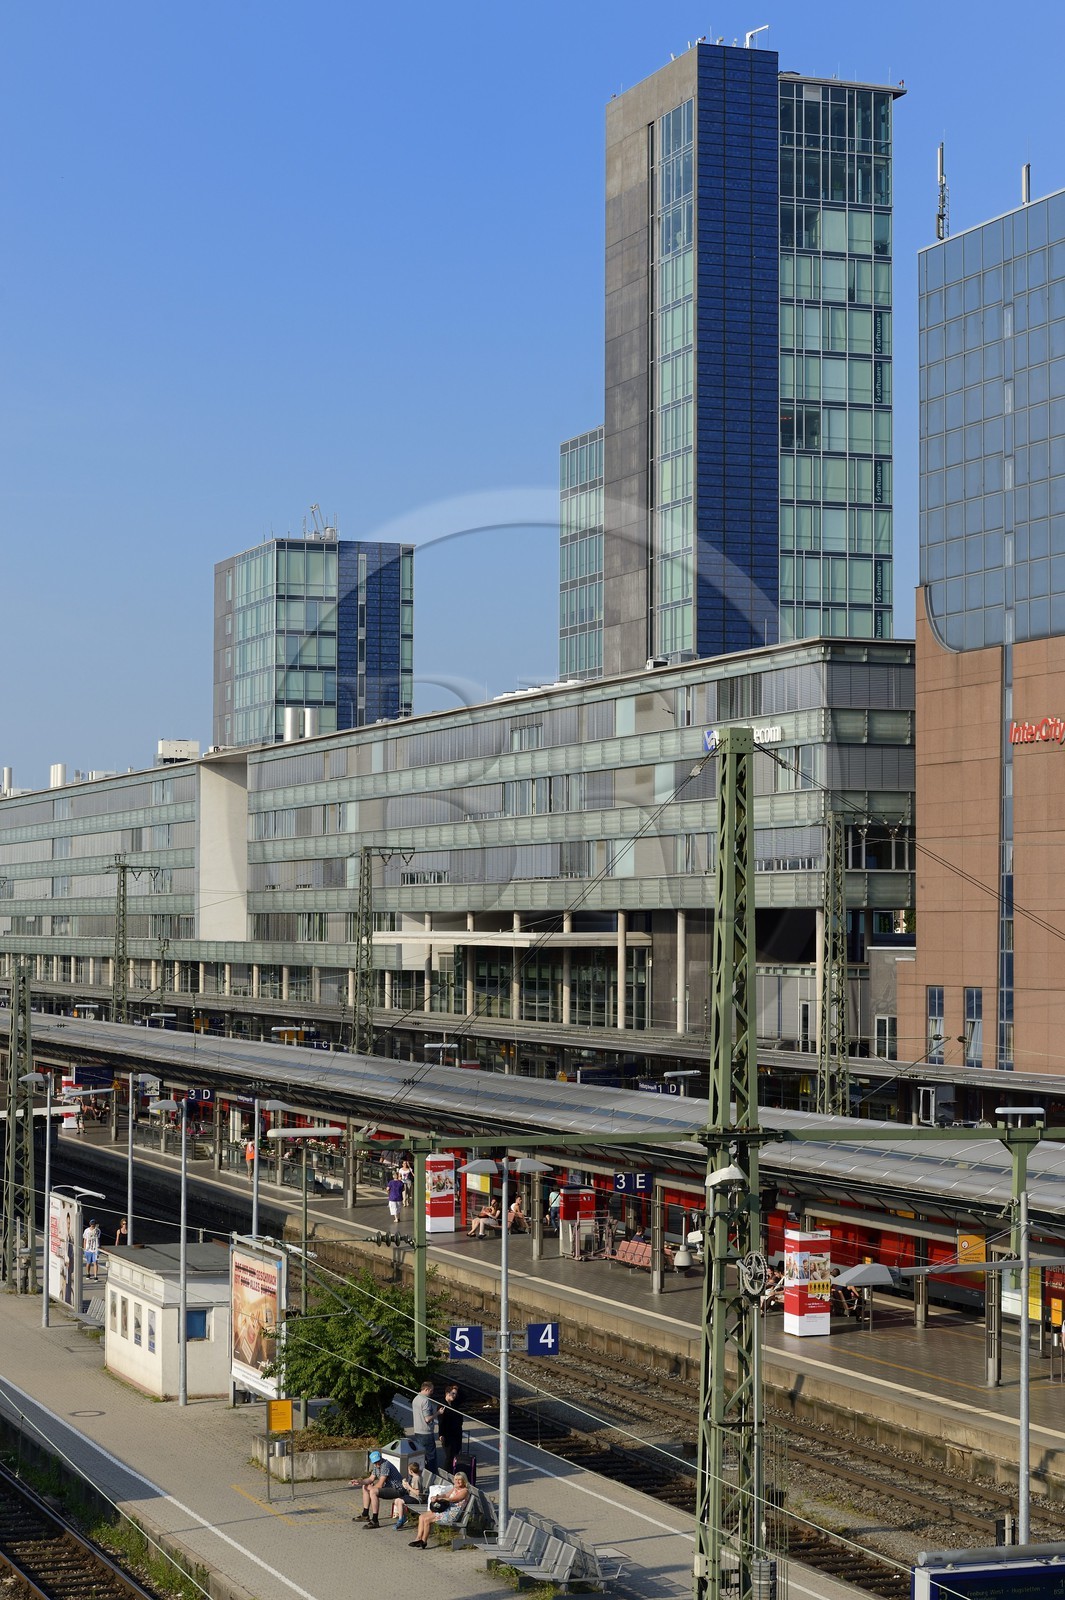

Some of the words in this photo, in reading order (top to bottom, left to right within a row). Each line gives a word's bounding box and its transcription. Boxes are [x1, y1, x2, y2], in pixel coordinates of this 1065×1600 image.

[1008, 717, 1065, 745] InterCity
[189, 1089, 196, 1099] 3
[202, 1089, 211, 1100] D
[657, 1084, 662, 1093] 1
[669, 1084, 677, 1094] D
[616, 1174, 626, 1189] 3
[636, 1174, 646, 1189] E
[454, 1327, 470, 1352] 5
[539, 1323, 555, 1348] 4
